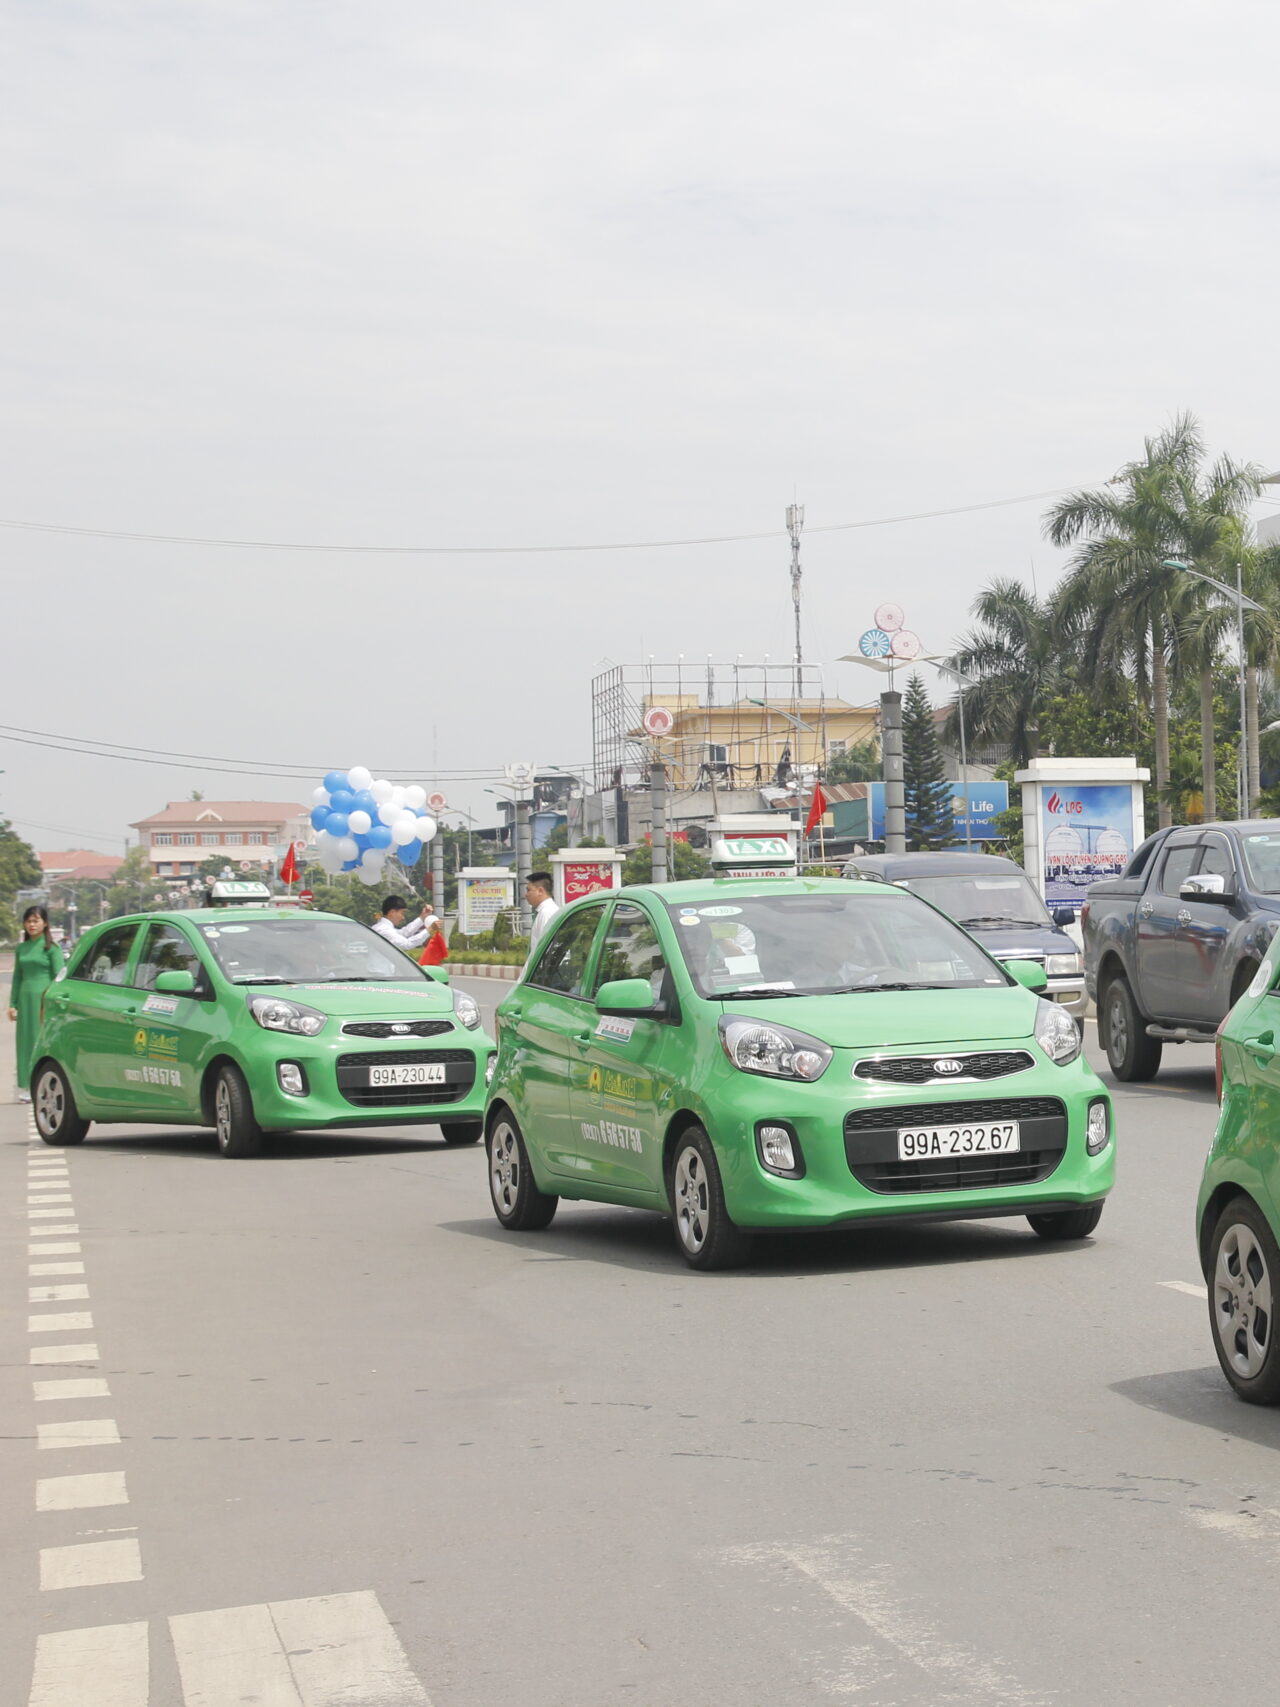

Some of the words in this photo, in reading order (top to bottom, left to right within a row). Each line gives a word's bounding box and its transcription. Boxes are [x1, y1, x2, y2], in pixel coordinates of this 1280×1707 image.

[972, 801, 994, 812] Life
[1065, 801, 1083, 814] LPG
[1093, 854, 1113, 864] QUANG
[1115, 854, 1127, 864] GAS
[937, 1062, 961, 1072] KIA
[372, 1067, 443, 1084] 99A-230.44
[903, 1125, 1014, 1157] 99A-232.67
